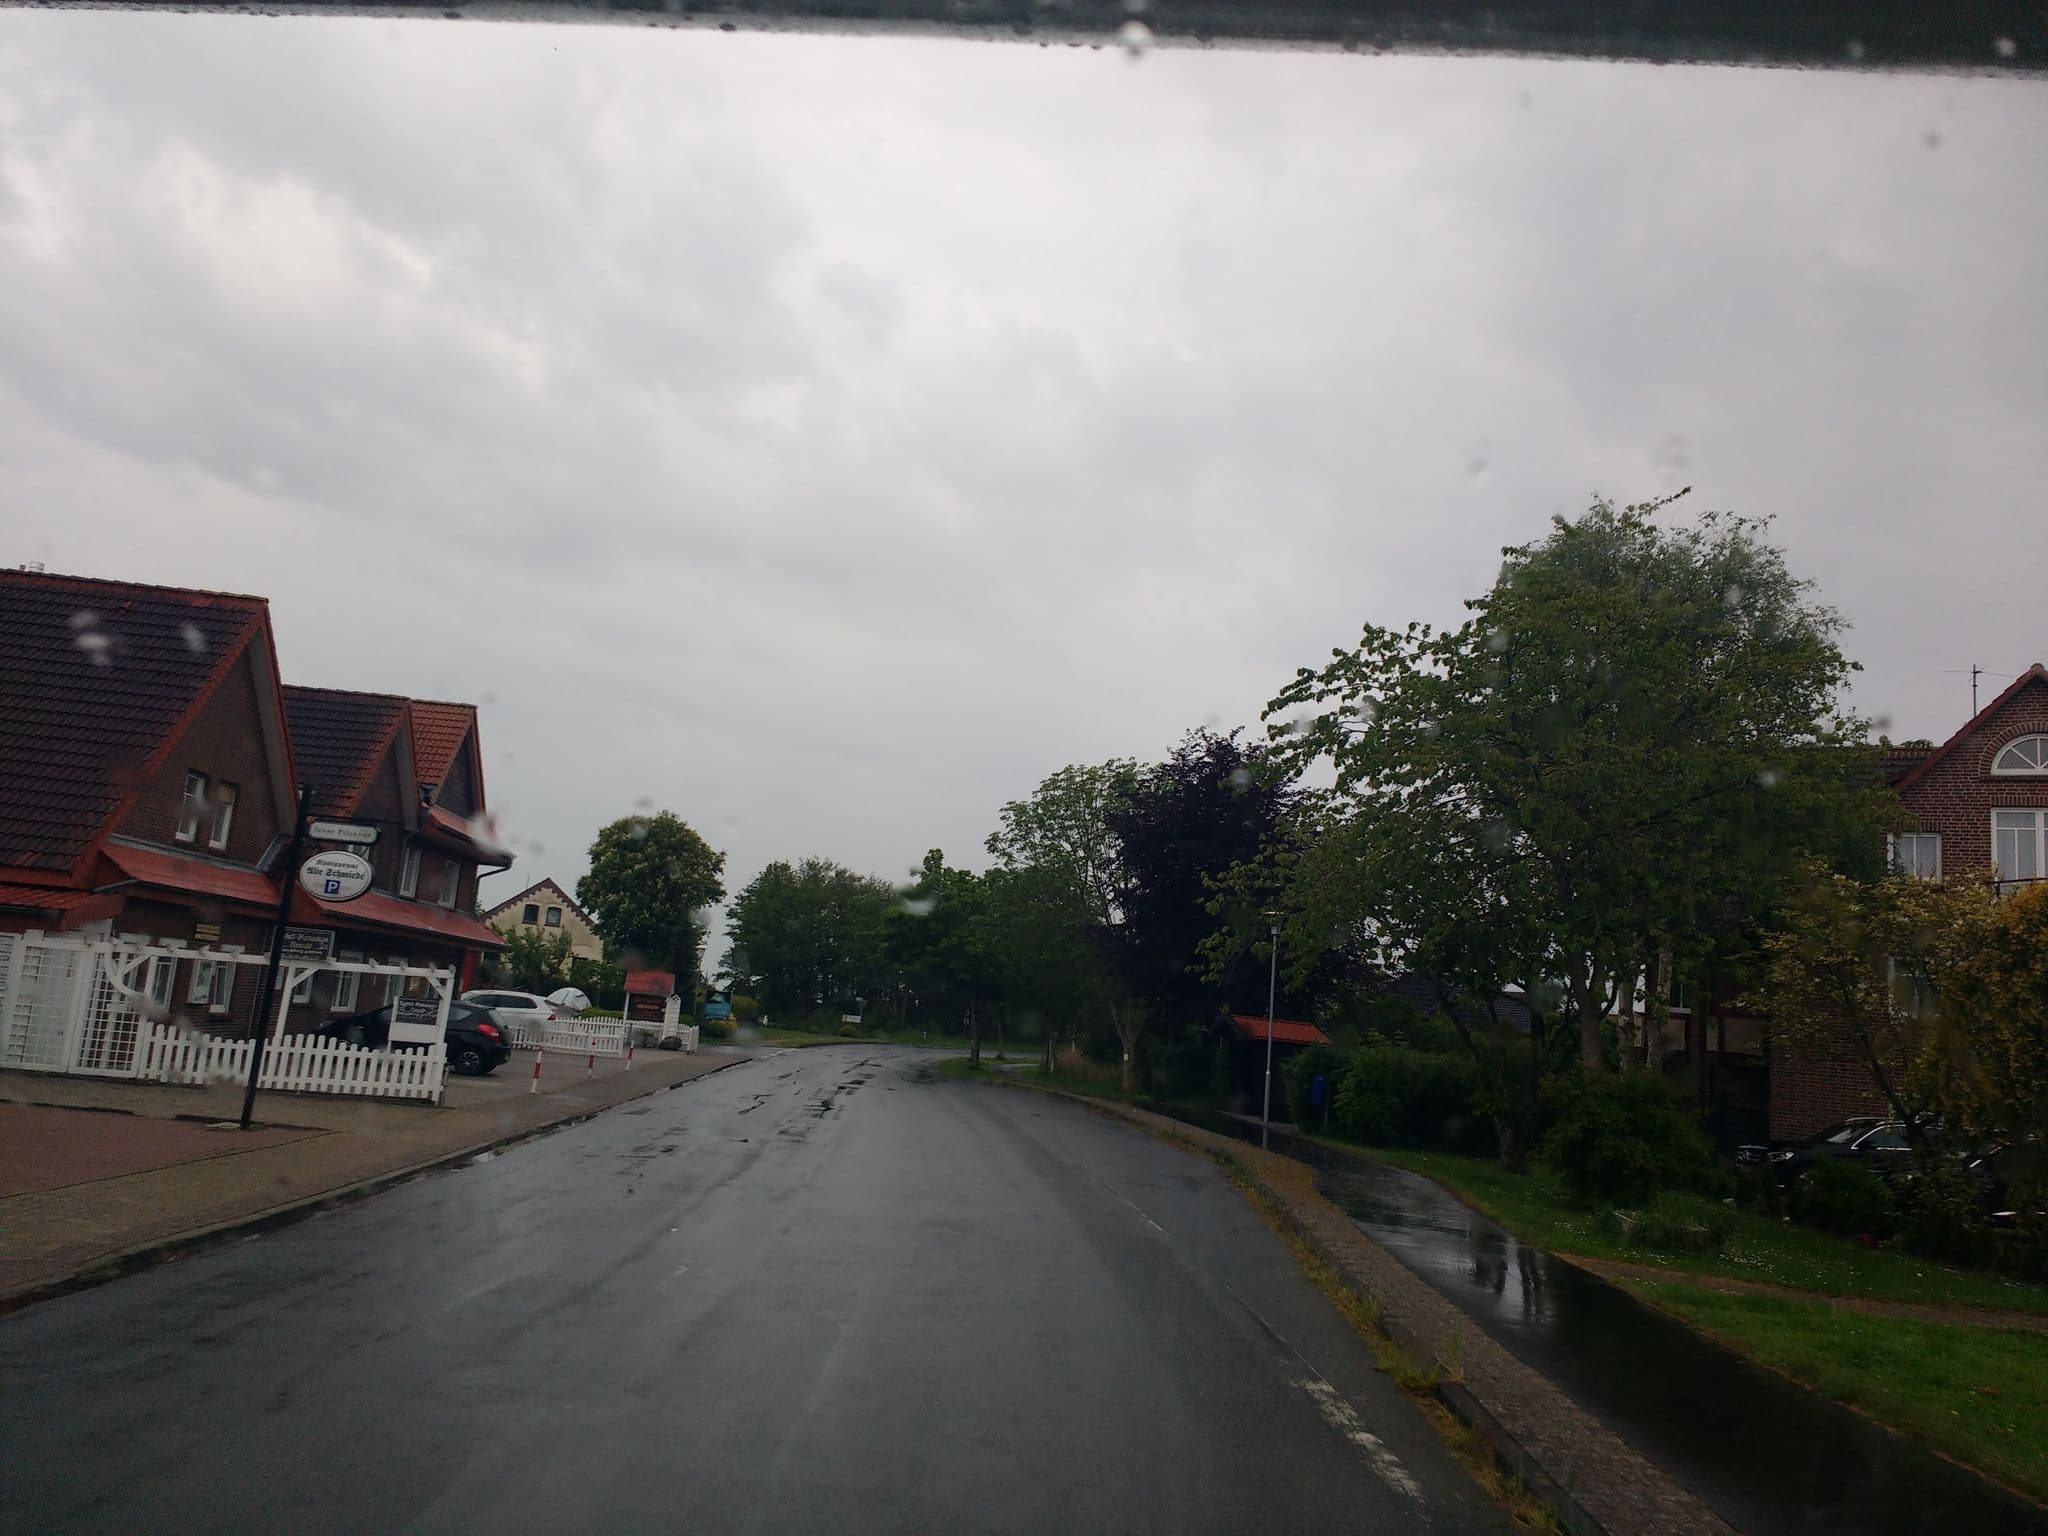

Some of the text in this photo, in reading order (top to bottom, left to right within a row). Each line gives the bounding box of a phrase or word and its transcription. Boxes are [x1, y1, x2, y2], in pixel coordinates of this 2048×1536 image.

[316, 859, 358, 869] Restaurant
[306, 866, 366, 880] Alte Schmiede
